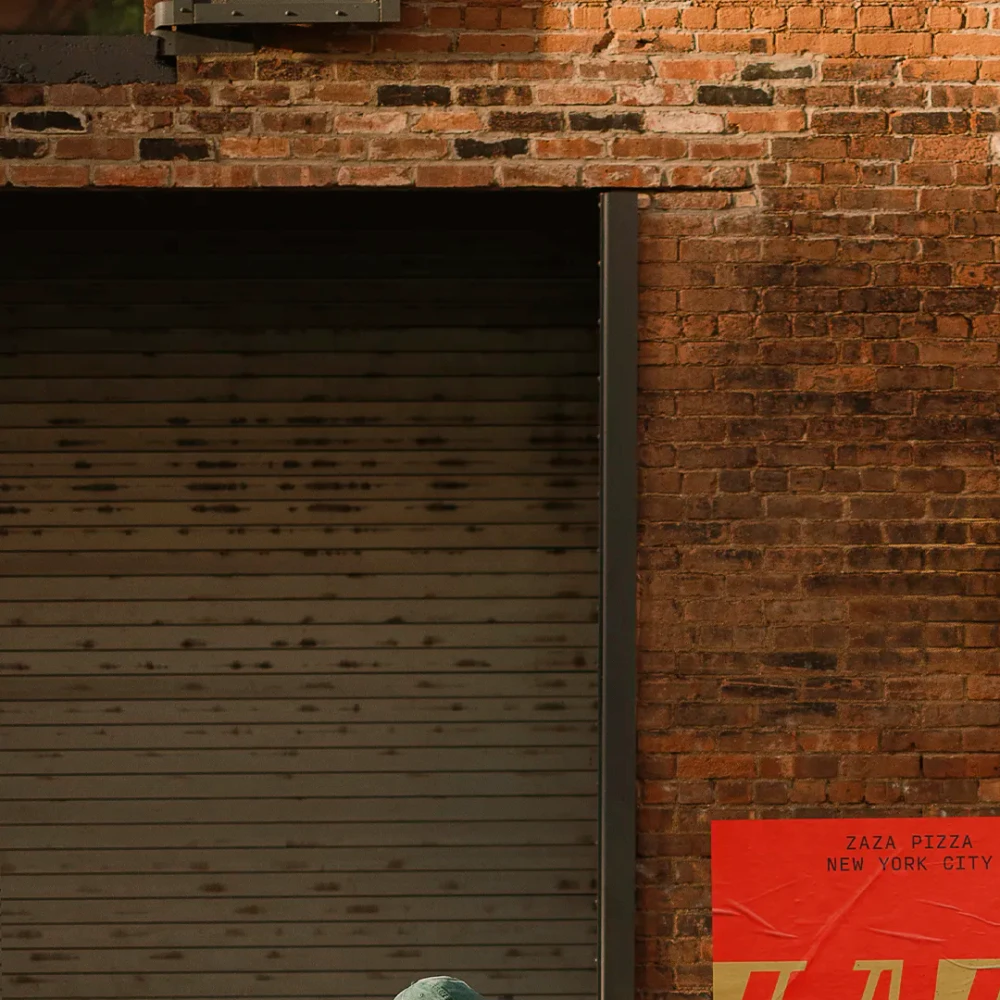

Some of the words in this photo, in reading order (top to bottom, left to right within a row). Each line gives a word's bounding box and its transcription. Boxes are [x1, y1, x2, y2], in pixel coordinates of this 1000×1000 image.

[845, 835, 897, 850] ZAZA
[911, 834, 973, 849] PIZZA
[826, 857, 864, 872] NEW
[878, 856, 928, 871] YORK
[942, 855, 993, 870] CITY
